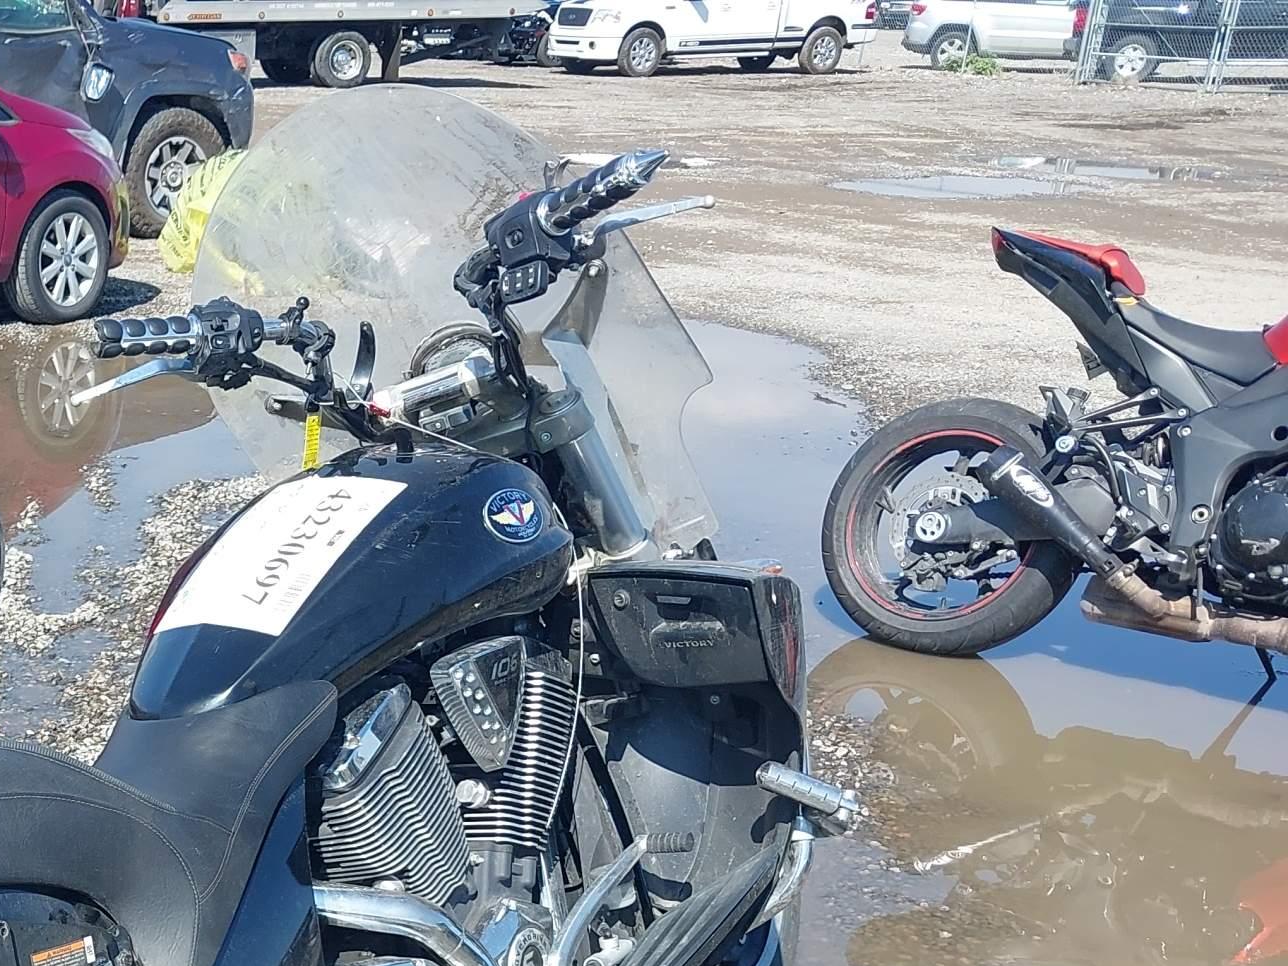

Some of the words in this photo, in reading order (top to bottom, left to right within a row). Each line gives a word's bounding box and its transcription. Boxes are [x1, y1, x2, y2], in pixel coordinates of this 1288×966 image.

[489, 491, 528, 512] VICTORY
[242, 489, 352, 605] 43230697
[663, 640, 713, 648] VICTORY
[492, 652, 519, 681] 106
